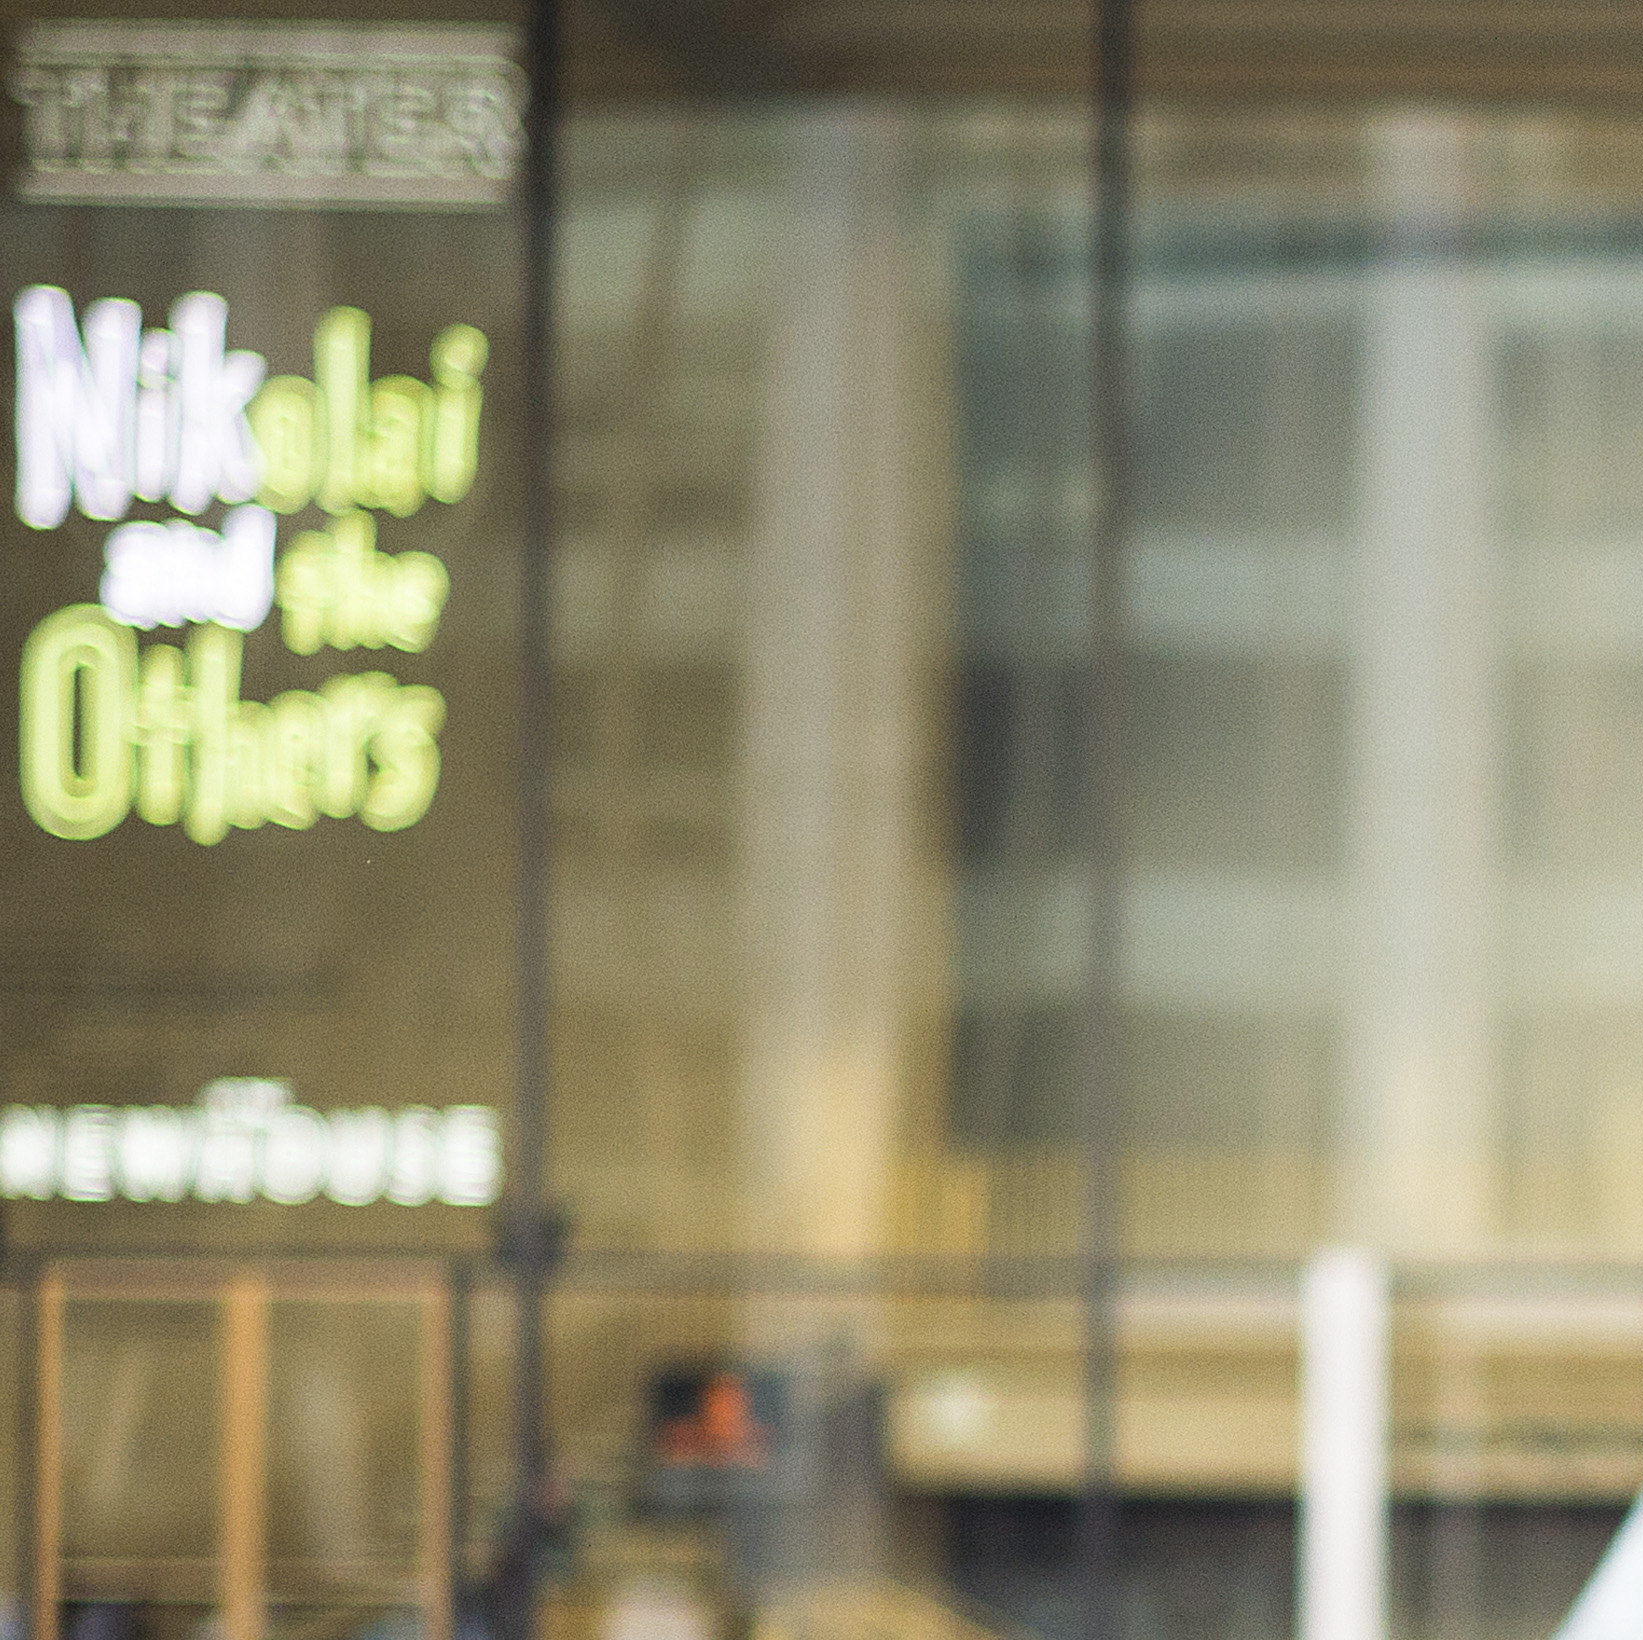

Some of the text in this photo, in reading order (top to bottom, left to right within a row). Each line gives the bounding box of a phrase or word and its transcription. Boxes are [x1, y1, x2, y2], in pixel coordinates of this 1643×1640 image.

[14, 60, 528, 176] THEATER
[15, 285, 489, 530] Nikolai
[19, 603, 446, 845] Others
